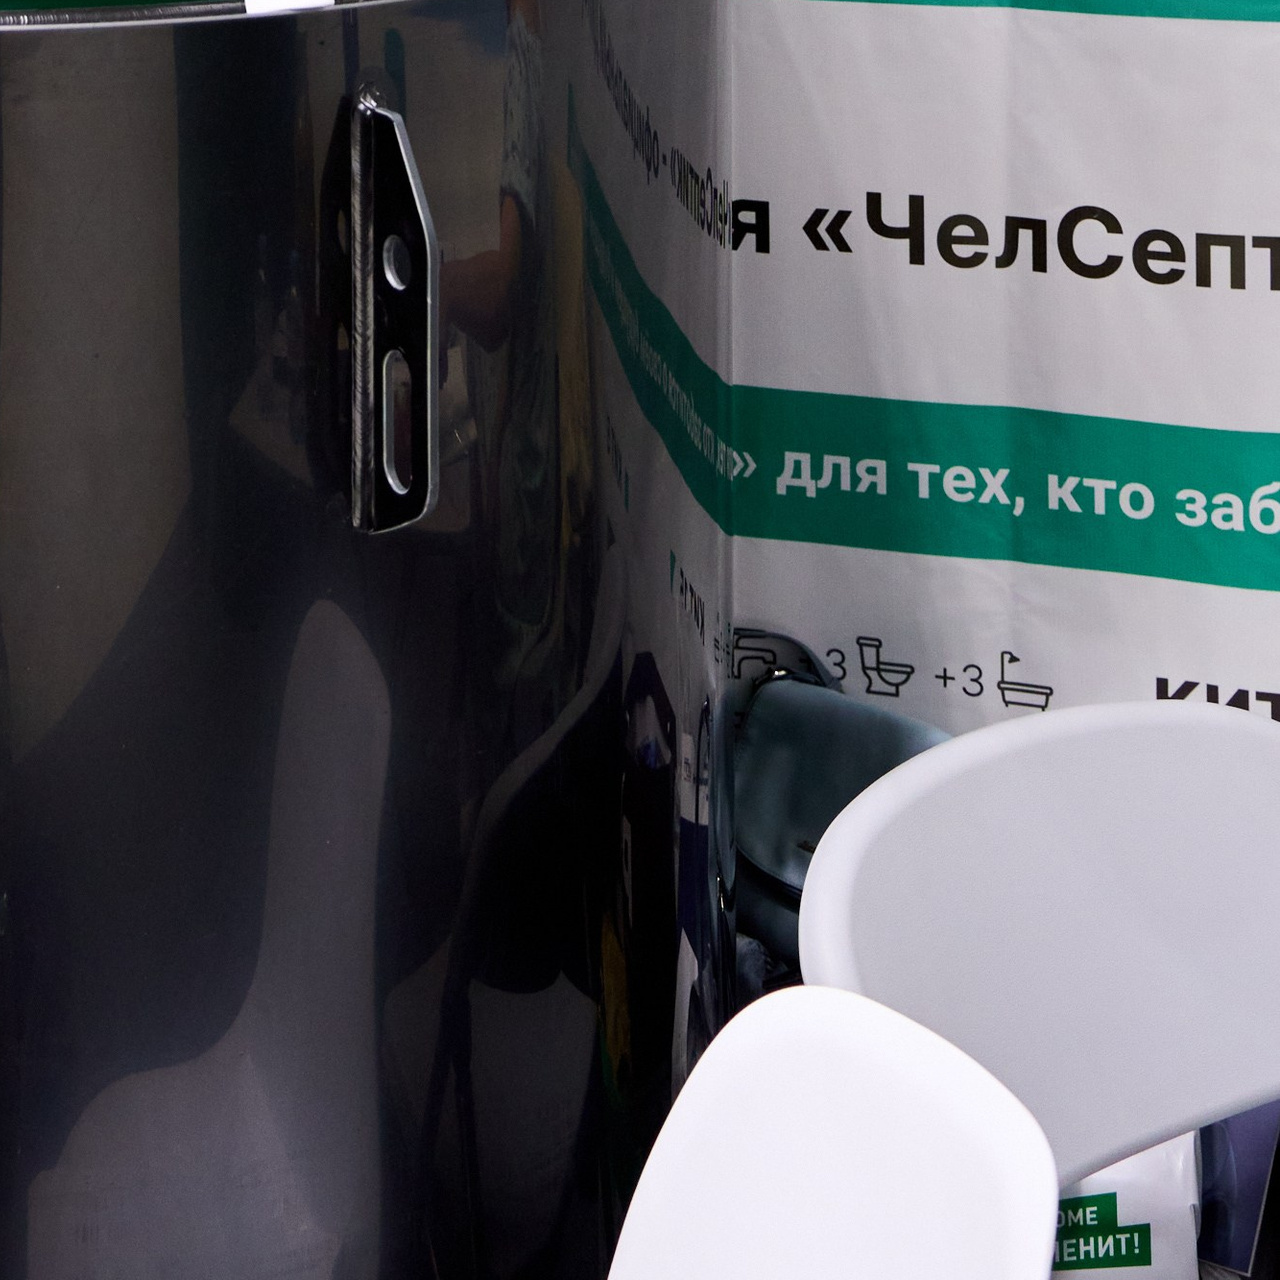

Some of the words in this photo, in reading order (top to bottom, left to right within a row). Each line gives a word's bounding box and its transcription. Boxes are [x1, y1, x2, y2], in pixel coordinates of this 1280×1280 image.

[776, 450, 888, 499] для
[907, 462, 1025, 517] тех,
[1047, 473, 1155, 520] кто
[934, 664, 984, 697] +3
